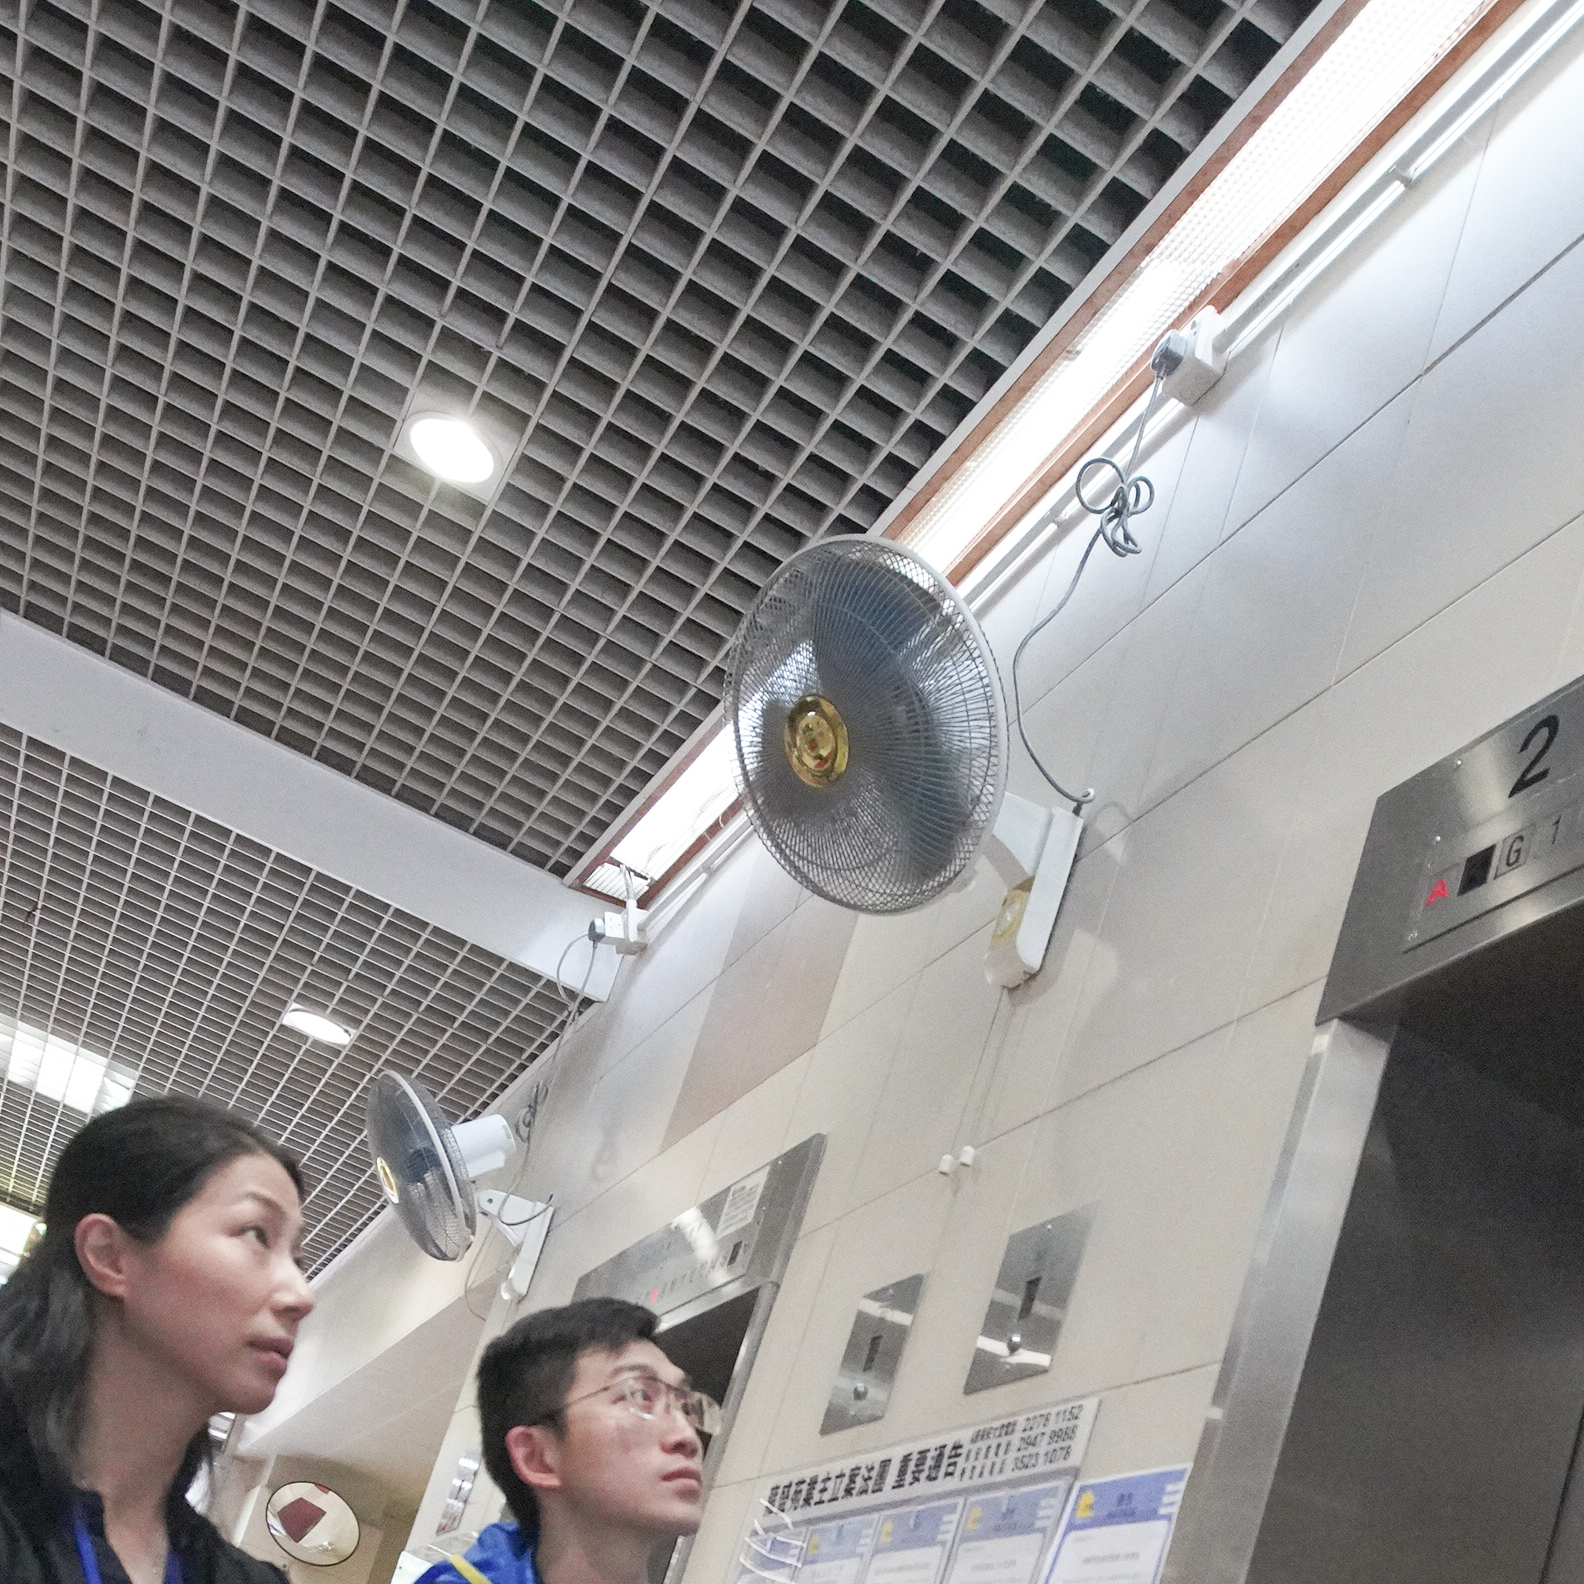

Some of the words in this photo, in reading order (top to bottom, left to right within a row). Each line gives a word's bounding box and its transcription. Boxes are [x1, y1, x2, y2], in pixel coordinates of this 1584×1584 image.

[1507, 714, 1560, 799] 2
[1506, 835, 1525, 868] G
[1551, 815, 1563, 845] 1
